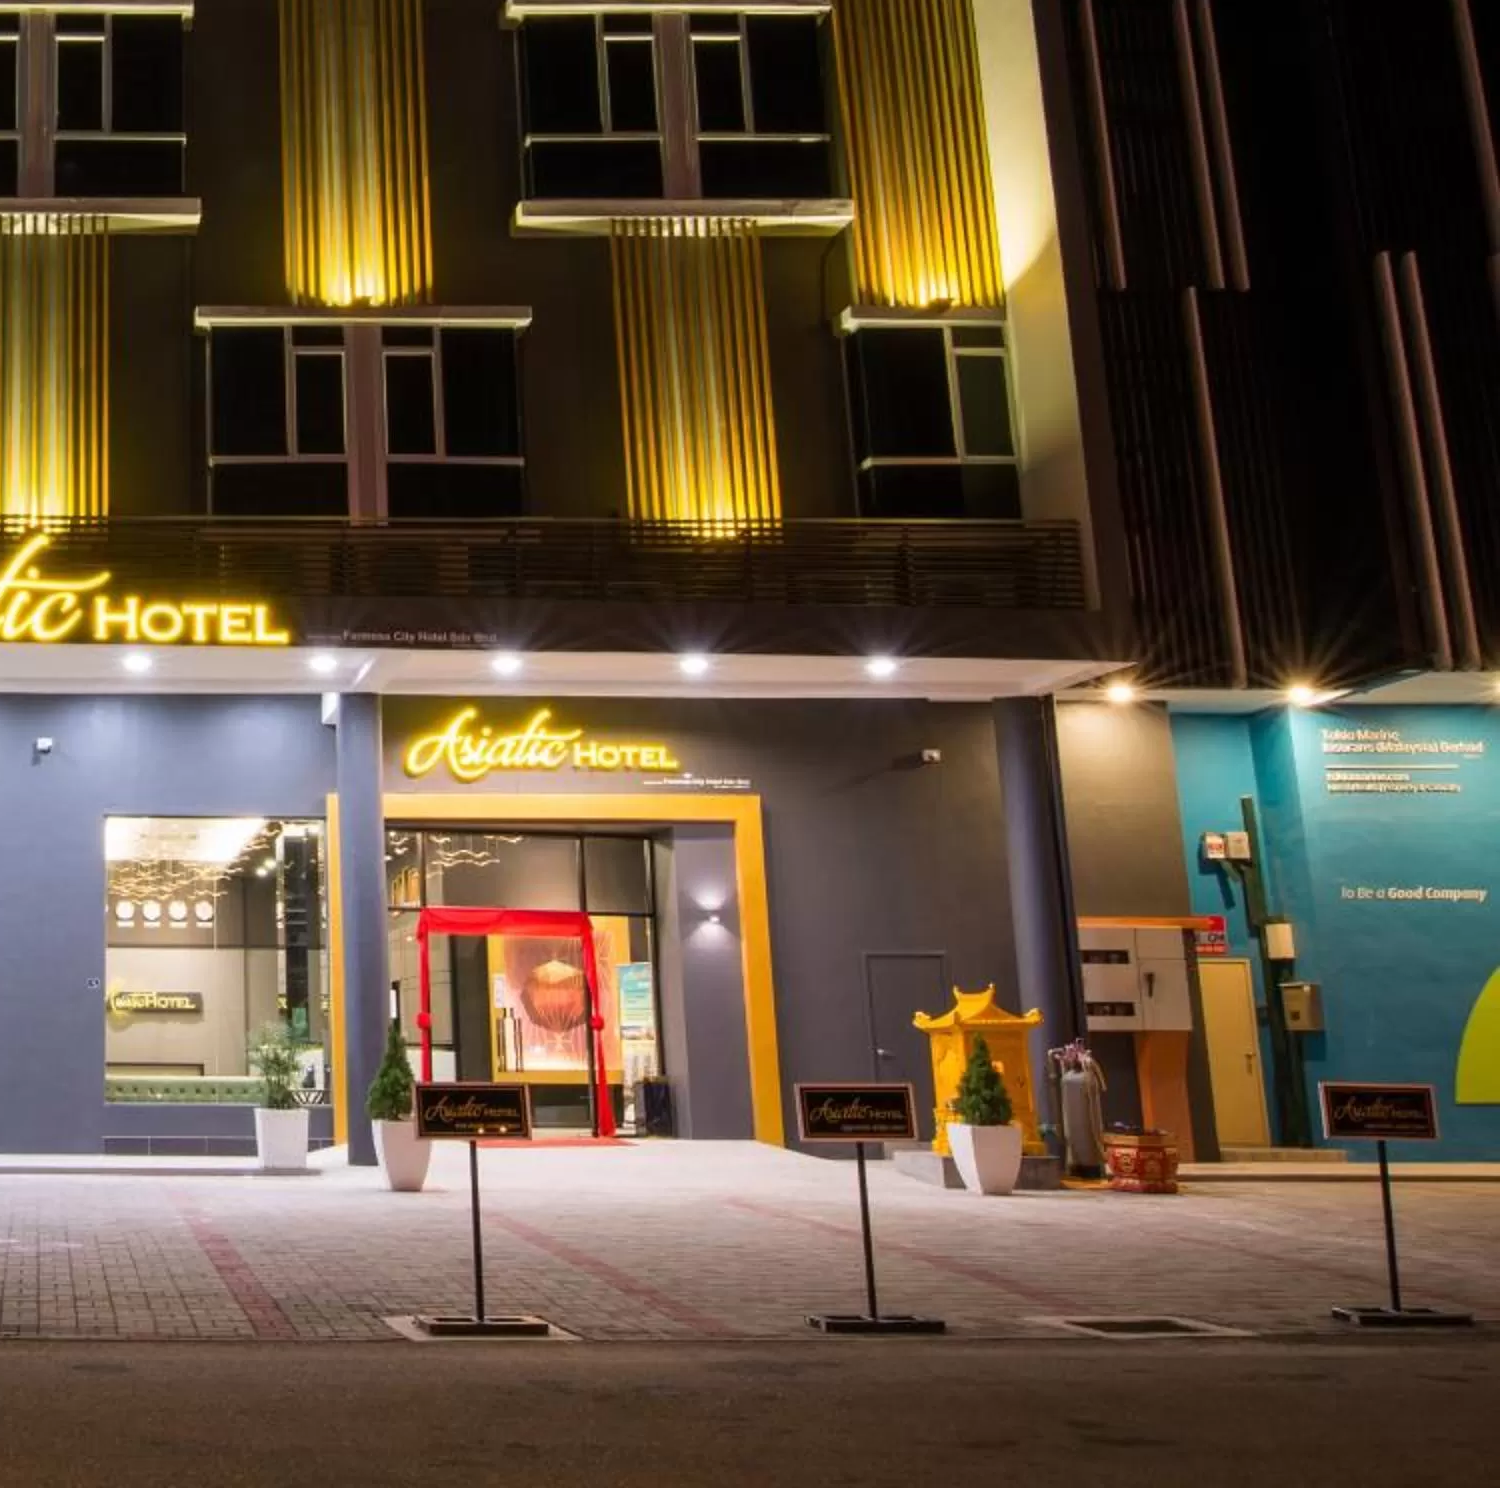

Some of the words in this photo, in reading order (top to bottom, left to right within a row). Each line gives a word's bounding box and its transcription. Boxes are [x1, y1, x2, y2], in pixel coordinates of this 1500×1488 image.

[93, 595, 290, 644] HOTEL
[393, 630, 416, 644] City
[405, 708, 583, 781] Asiatic
[573, 743, 679, 769] HOTEL
[1357, 886, 1374, 899] Be
[1376, 889, 1386, 899] a
[1388, 886, 1423, 899] Good
[1425, 886, 1488, 902] Company
